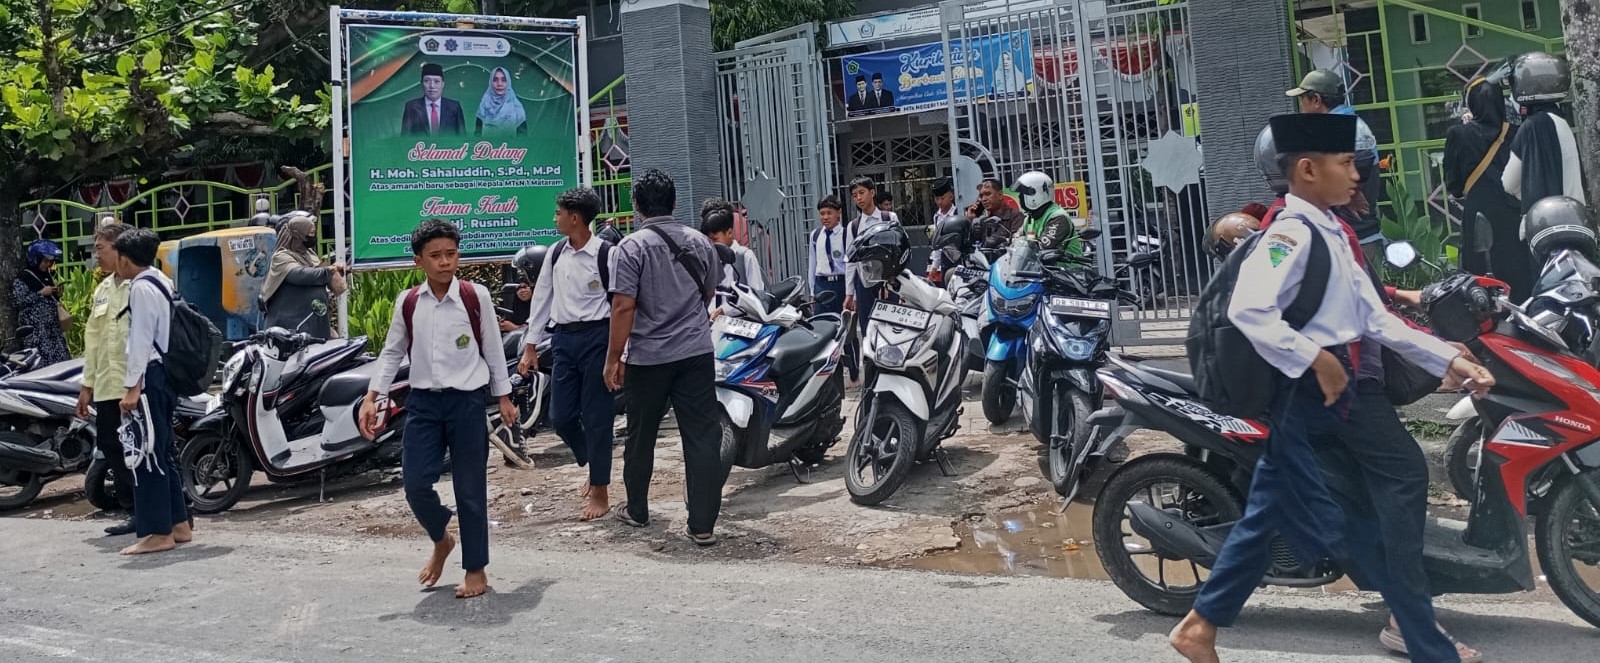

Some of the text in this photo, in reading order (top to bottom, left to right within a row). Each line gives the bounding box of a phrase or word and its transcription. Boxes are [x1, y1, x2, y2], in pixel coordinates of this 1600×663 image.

[408, 141, 528, 164] Selamat Datang
[370, 165, 561, 179] H. Moh. Sahaluddin, S.Pd., M.Pd
[370, 183, 390, 191] Atas
[425, 182, 445, 190] baru
[445, 181, 476, 190] sebagai
[477, 180, 503, 189] Kepala
[530, 179, 564, 187] Mataram
[1054, 185, 1079, 209] AS
[420, 194, 519, 217] Terima Kasih
[471, 217, 518, 228] Rusniah
[370, 236, 390, 244] Atas
[504, 230, 531, 238] selama
[466, 242, 474, 250] di
[475, 242, 496, 250] MTsN
[502, 240, 536, 248] Mataram
[1555, 415, 1592, 432] HONDA
